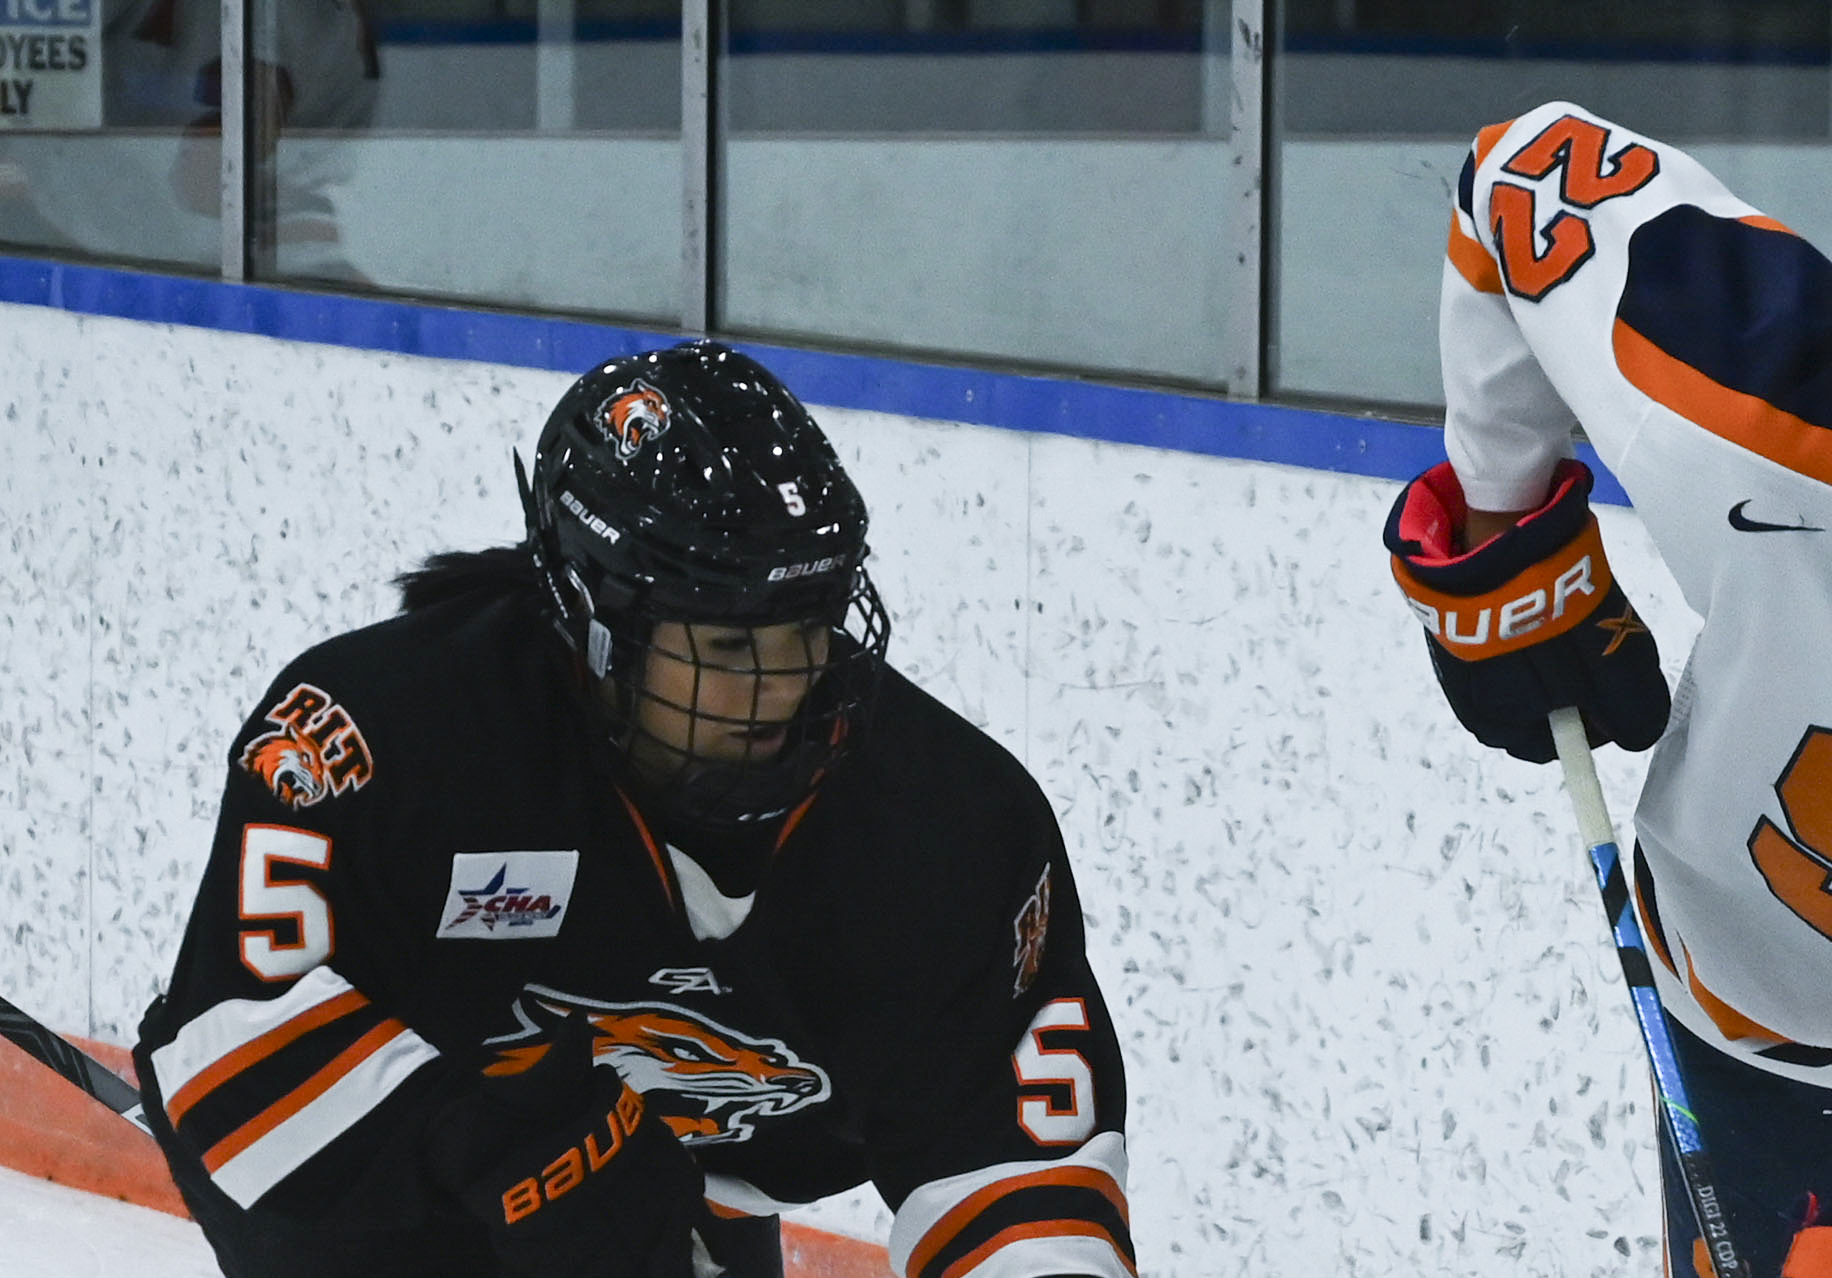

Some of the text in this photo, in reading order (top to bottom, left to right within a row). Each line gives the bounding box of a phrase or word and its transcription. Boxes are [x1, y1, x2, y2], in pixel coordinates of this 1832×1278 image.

[0, 34, 86, 71] YEES
[1489, 114, 1660, 303] 22
[776, 482, 807, 517] 5
[265, 682, 374, 799] RIT
[239, 822, 335, 983] 5
[483, 895, 552, 913] CHA
[1011, 997, 1097, 1148] 5
